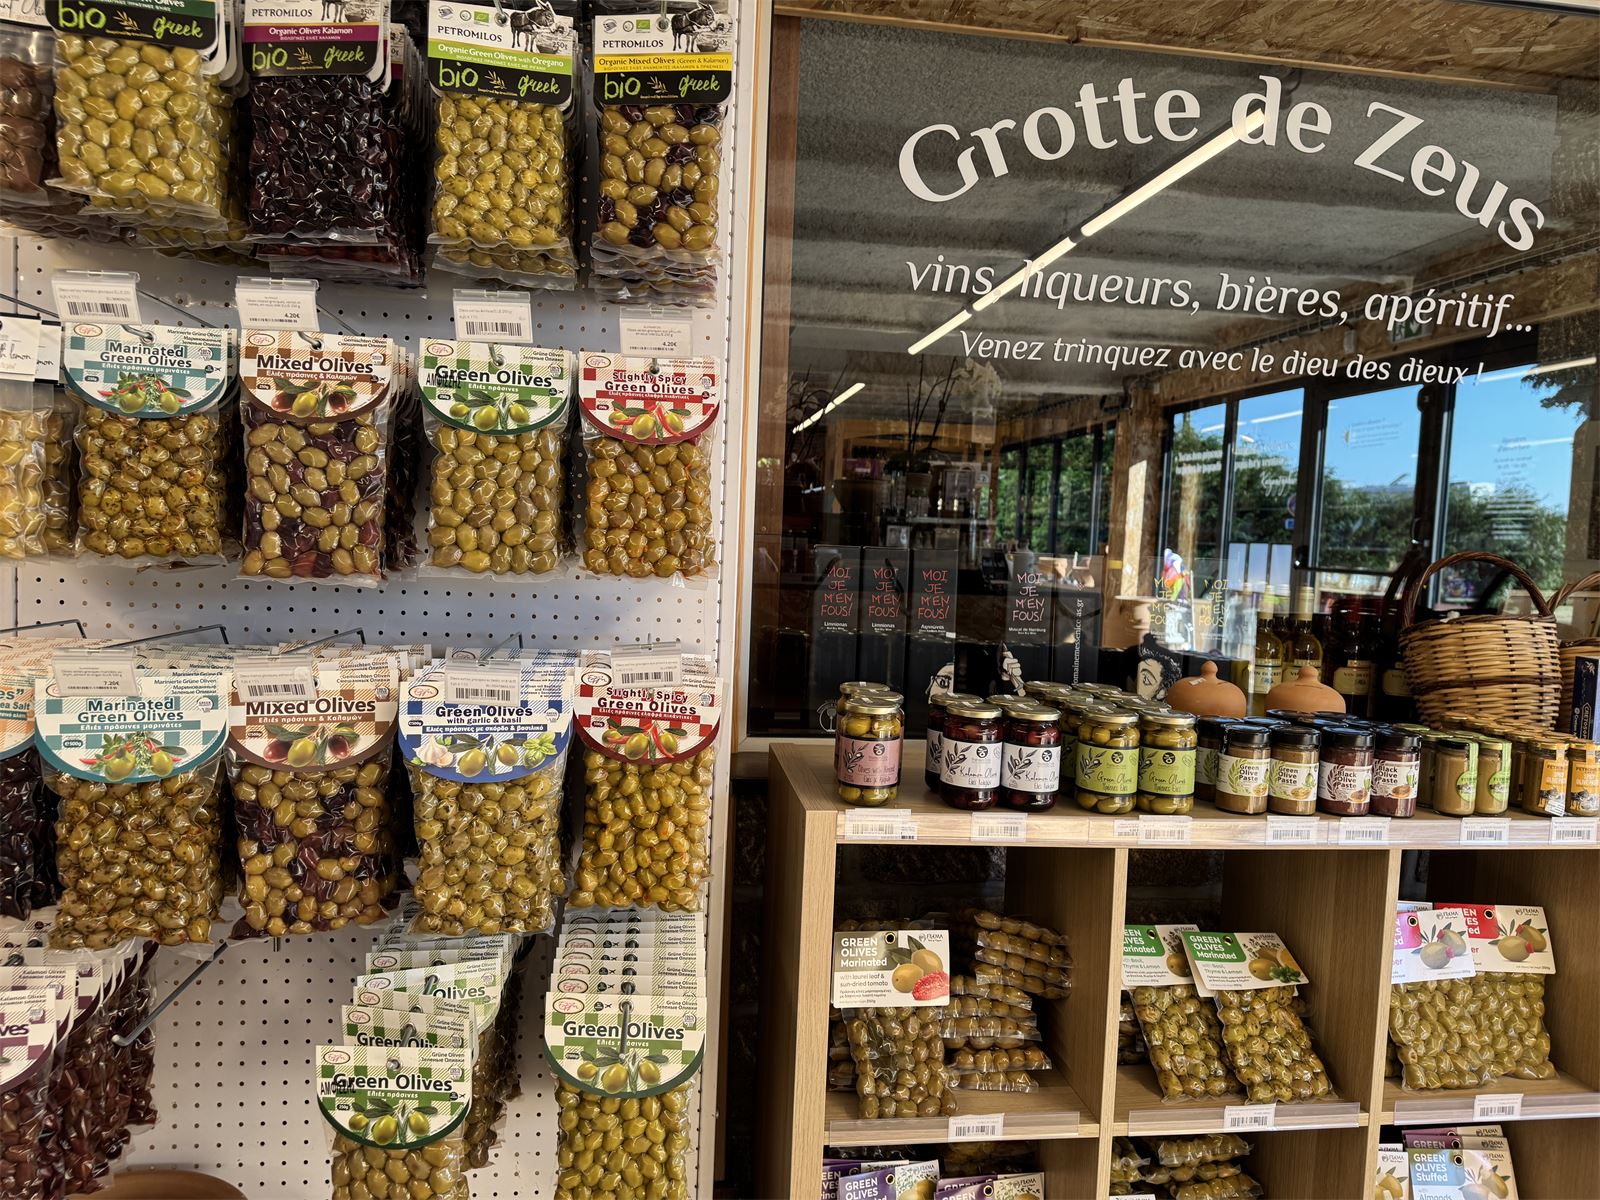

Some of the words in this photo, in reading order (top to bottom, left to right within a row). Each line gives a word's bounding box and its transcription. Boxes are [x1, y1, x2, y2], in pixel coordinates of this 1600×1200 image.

[59, 0, 106, 29] bio
[252, 8, 313, 17] PETROMILOS
[269, 27, 298, 36] Organic
[299, 26, 321, 35] Olives
[322, 26, 353, 35] Kalamon
[437, 25, 503, 42] PETROMILOS
[602, 40, 664, 48] PETROMILOS
[252, 43, 288, 71] bio
[438, 44, 469, 55] Organic
[468, 48, 493, 58] Green
[494, 51, 517, 62] Olives
[532, 58, 564, 68] Oregano
[598, 58, 627, 67] Organic
[628, 57, 651, 65] Mixed
[652, 56, 675, 64] Olives
[440, 60, 479, 88] bio
[604, 73, 641, 100] bio
[898, 77, 1201, 202] Grotte
[1231, 75, 1332, 153] de
[1353, 101, 1545, 252] Zeus
[1216, 272, 1348, 326] bières,
[1364, 288, 1532, 338] apéritif...
[109, 341, 185, 358] Marinated
[100, 351, 142, 365] Green
[148, 355, 192, 368] Olives
[960, 330, 1045, 361] Venez
[1053, 337, 1171, 371] trinquez
[1178, 349, 1243, 371] avec
[1251, 347, 1274, 373] le
[1282, 350, 1338, 377] dieu
[1346, 354, 1391, 381] des
[1399, 357, 1469, 385] dieux
[257, 354, 313, 370] Mixed
[319, 357, 374, 374] Olives
[435, 365, 490, 383] Green
[497, 370, 552, 387] Olives
[613, 372, 653, 383] Slightly
[658, 374, 687, 384] Spicy
[605, 381, 646, 392] Green
[652, 383, 695, 395] Olives
[827, 566, 851, 579] MOI
[922, 568, 948, 582] MOI
[1017, 572, 1043, 585] MOI
[828, 580, 848, 591] JE
[875, 581, 896, 592] JE
[925, 583, 945, 594] JE
[1019, 586, 1039, 597] JE
[824, 593, 853, 604] M'EN
[921, 595, 951, 607] M'EN
[1209, 592, 1224, 602] JE
[1015, 598, 1045, 609] M'EN
[820, 604, 853, 617] FOUS!
[868, 605, 900, 618] FOUS!
[918, 605, 950, 620] FOUS!
[1012, 607, 1045, 623] FOUS!
[656, 691, 688, 703] Spicy
[88, 698, 174, 711] Marinated
[246, 700, 308, 715] Mixed
[315, 697, 376, 714] Olives
[597, 697, 644, 710] Green
[649, 700, 697, 714] Olives
[78, 713, 130, 723] Green
[133, 710, 184, 722] Olives
[435, 706, 482, 717] Green
[486, 705, 533, 717] Olives
[467, 717, 491, 726] garlic
[501, 716, 522, 724] basil
[1279, 766, 1299, 774] Green
[1337, 771, 1357, 779] Black
[1378, 765, 1398, 773] Black
[1379, 771, 1398, 779] Olive
[1277, 777, 1297, 785] Paste
[1336, 781, 1357, 789] Paste
[1337, 776, 1357, 784] Olive
[1377, 776, 1398, 785] Paste
[841, 938, 878, 947] GREEN
[1190, 935, 1221, 943] GREEN
[841, 948, 878, 957] OLIVES
[1193, 943, 1225, 952] OLIVES
[1198, 951, 1237, 960] Marinated
[840, 957, 888, 968] Marinated
[433, 986, 486, 999] Olives
[563, 1021, 620, 1036] Green
[627, 1022, 684, 1039] Olives
[333, 1074, 389, 1089] Green
[395, 1075, 453, 1092] Olives
[1413, 1153, 1446, 1162] GREEN
[1415, 1163, 1447, 1172] OLIVES
[1416, 1172, 1448, 1182] Stuffed
[845, 1177, 878, 1191] GREEN
[845, 1187, 879, 1200] OLIVES
